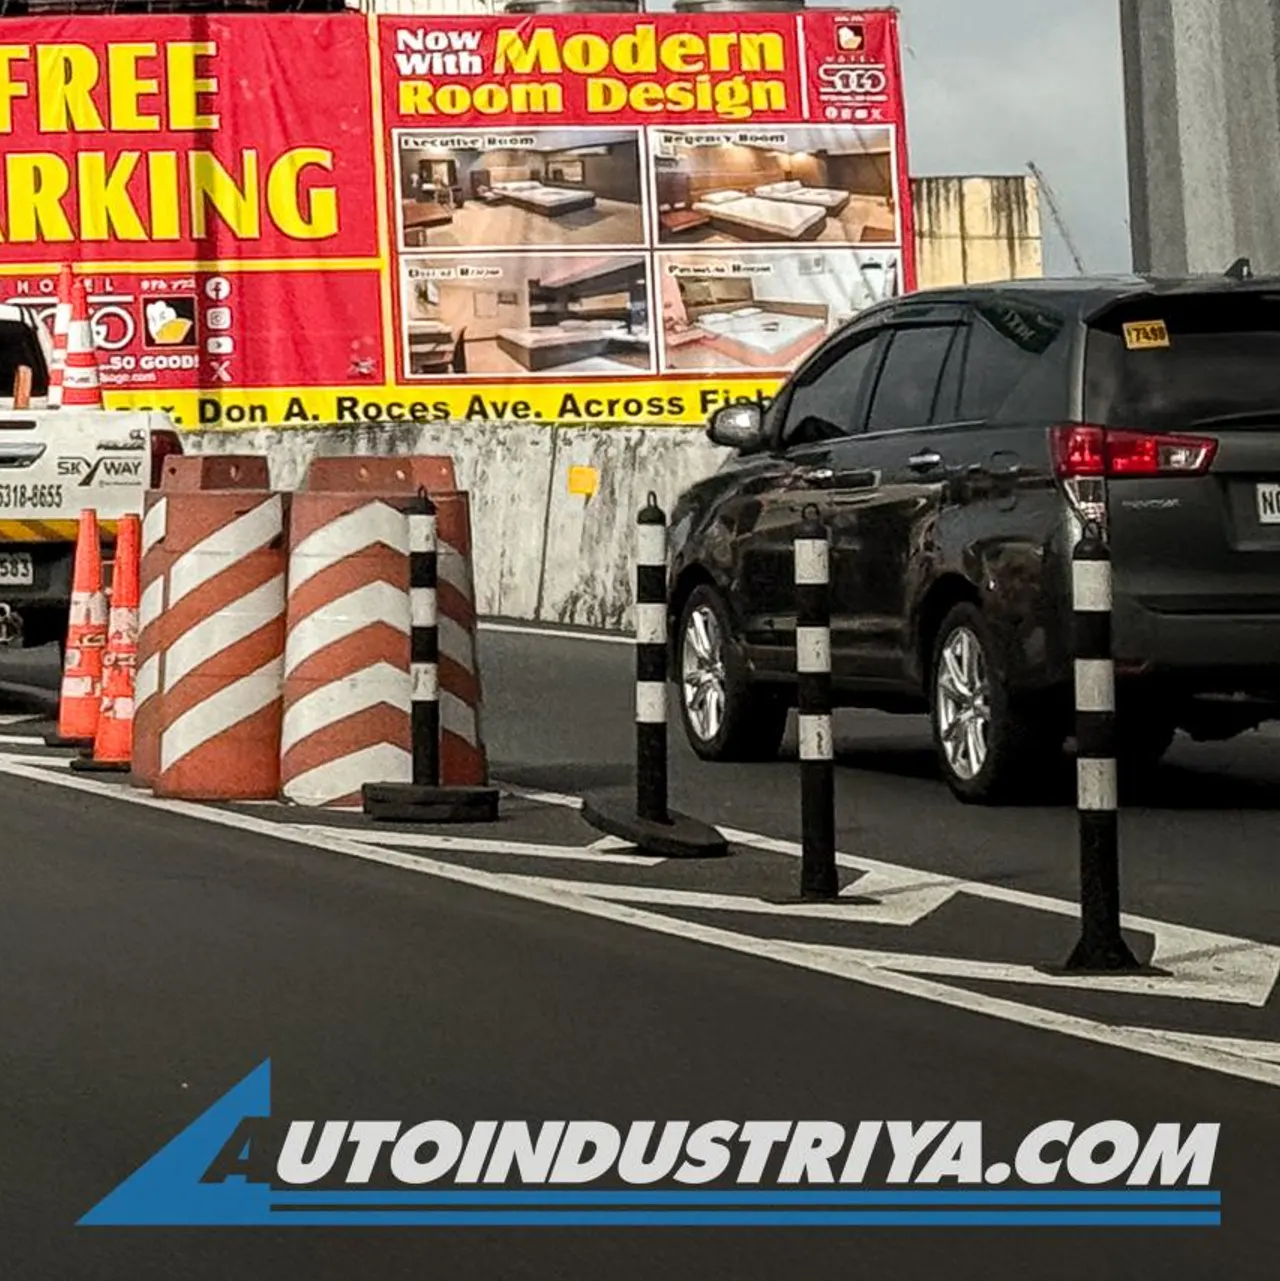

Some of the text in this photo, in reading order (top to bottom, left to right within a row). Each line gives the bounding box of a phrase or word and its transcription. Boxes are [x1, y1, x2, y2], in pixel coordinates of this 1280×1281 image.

[394, 51, 483, 76] With
[396, 23, 786, 75] Now Modern
[398, 74, 787, 120] Room Design
[140, 354, 200, 370] GOOD!
[197, 397, 268, 422] Don
[283, 397, 320, 422] A.
[336, 395, 451, 421] Roces
[465, 394, 543, 420] Ave.
[557, 392, 685, 419] Across
[57, 457, 143, 487] SKYWAY
